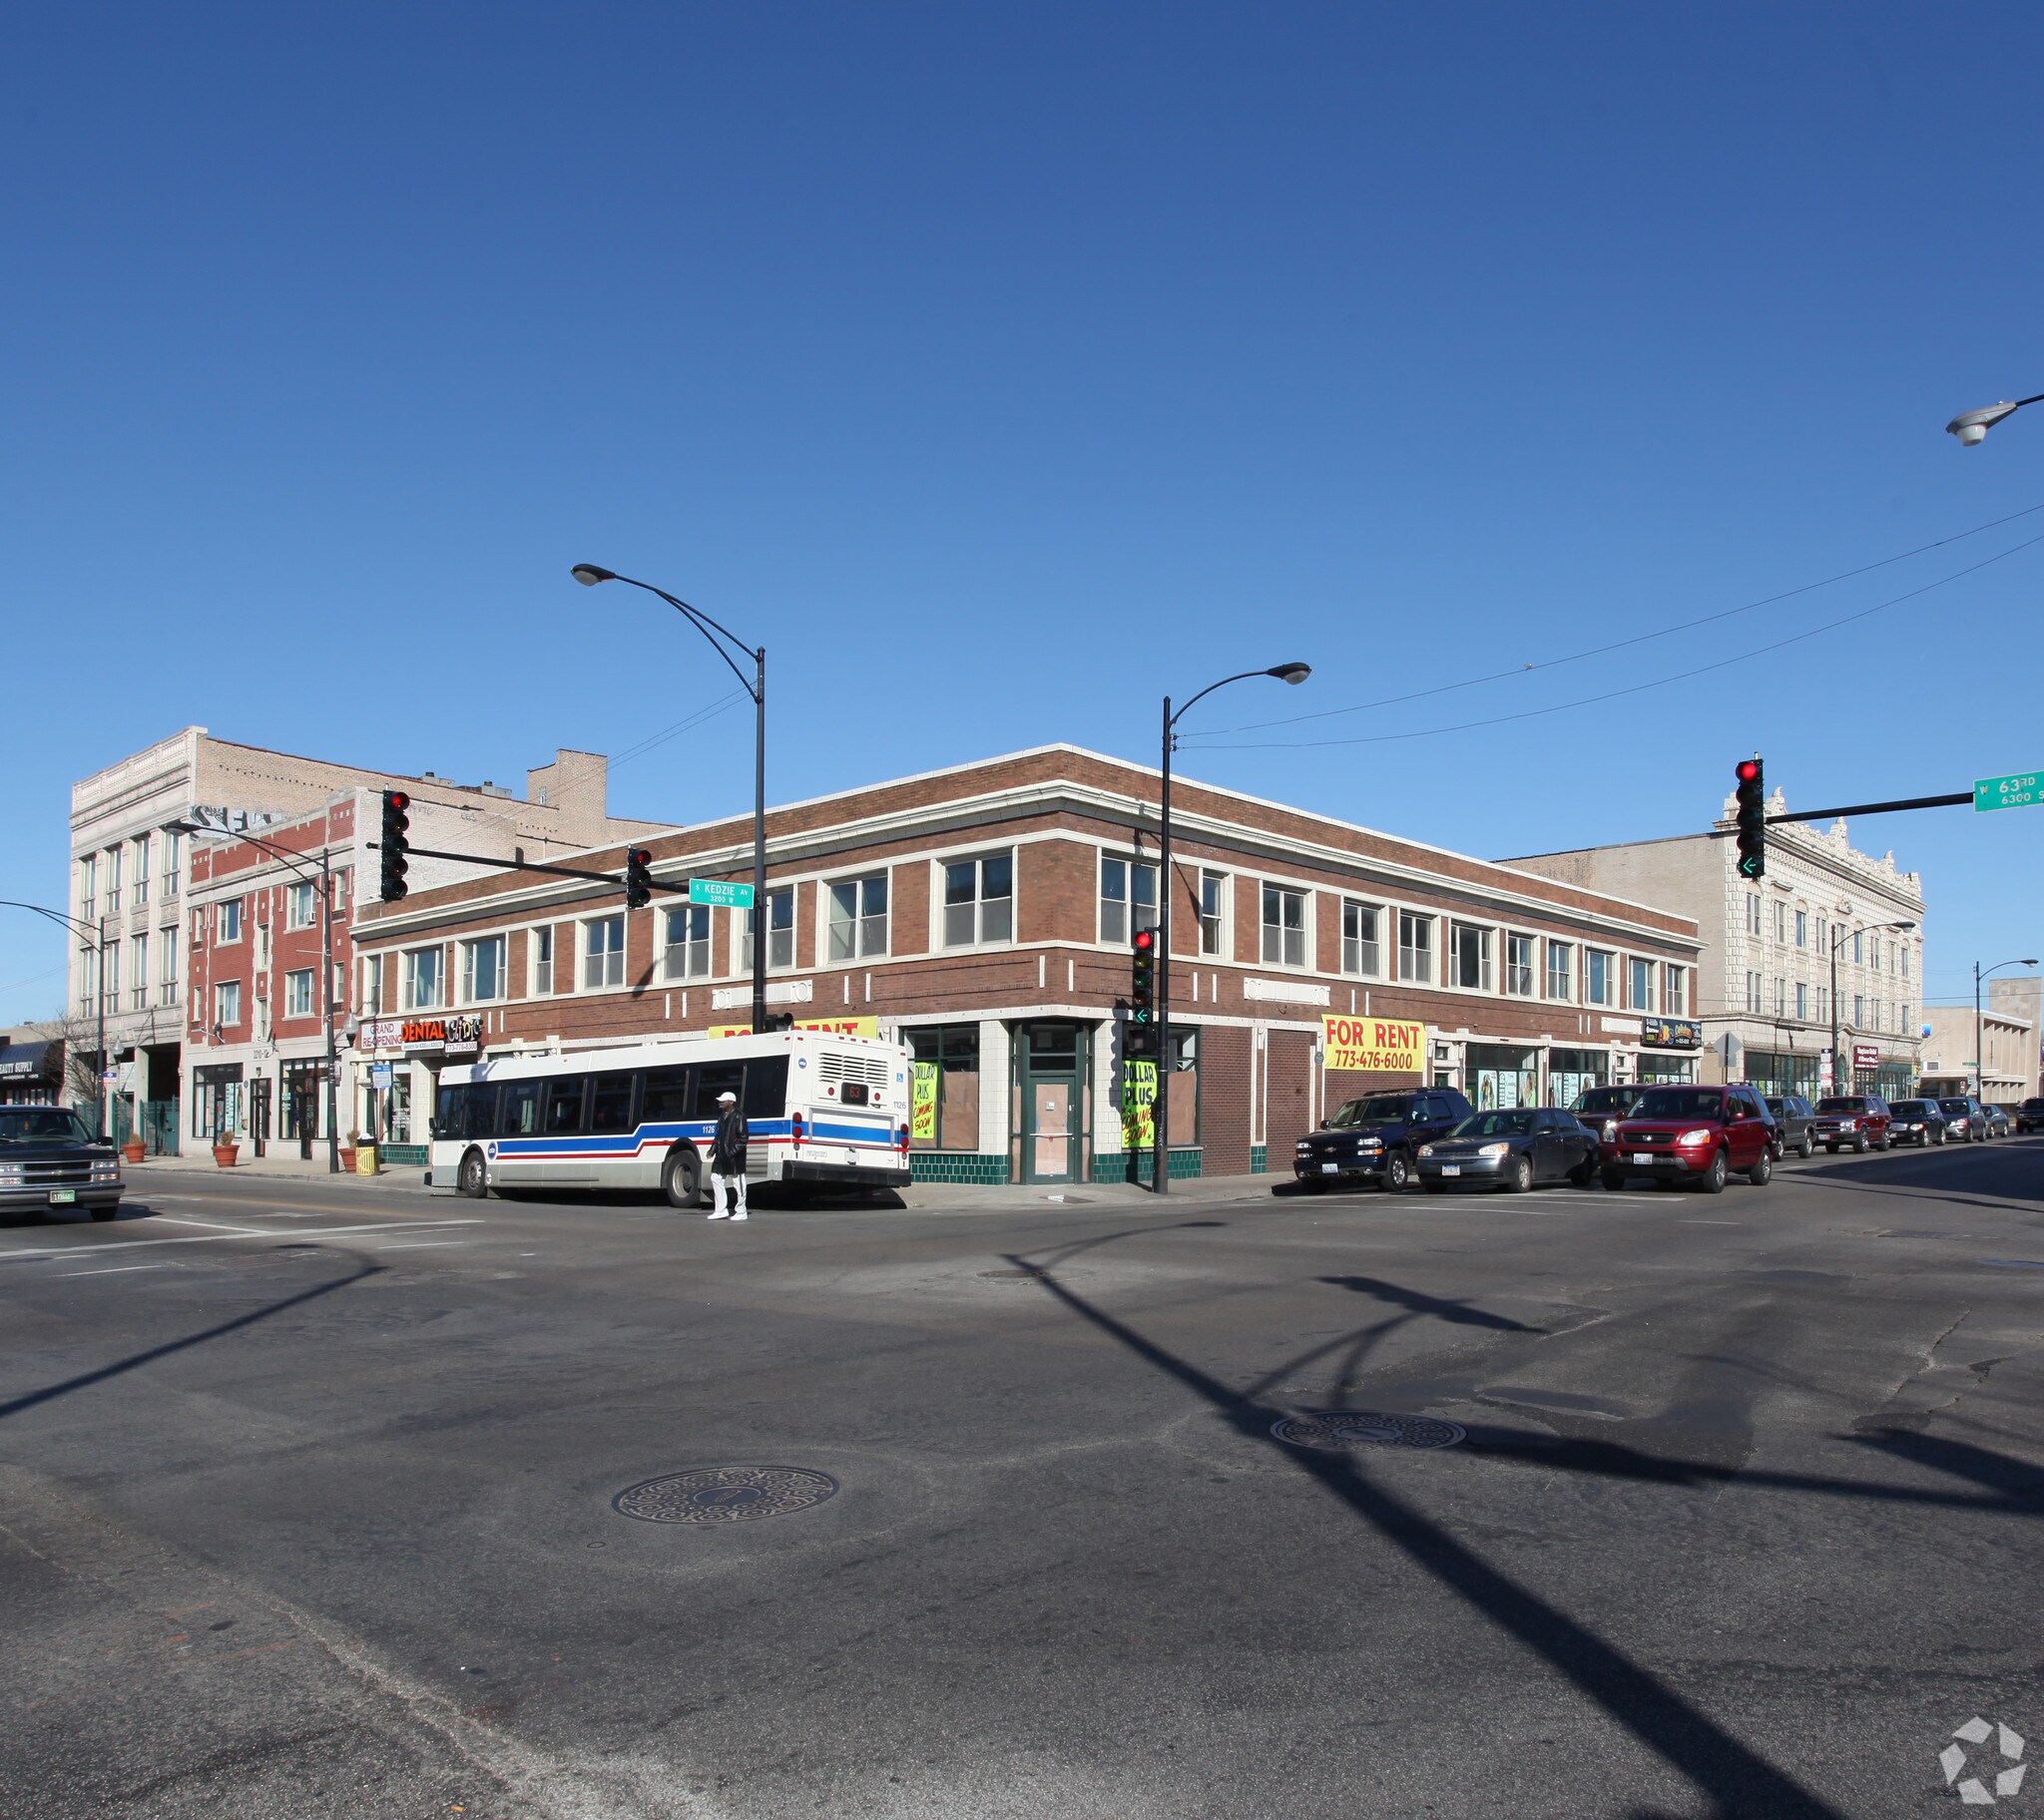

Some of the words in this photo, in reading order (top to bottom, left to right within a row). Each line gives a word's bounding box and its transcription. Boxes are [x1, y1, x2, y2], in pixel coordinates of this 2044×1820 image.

[1979, 785, 1988, 795] W
[1999, 776, 2035, 793] 63RD
[2001, 792, 2031, 805] 6300
[704, 884, 735, 896] KEDZIE
[370, 1023, 394, 1035] GRAND
[401, 1020, 445, 1042] DENTAL
[1326, 1019, 1363, 1047] FOR
[1374, 1023, 1419, 1050] RENT
[15, 1061, 33, 1073] SUPPLY
[1335, 1050, 1412, 1070] 773-476-6000
[915, 1065, 935, 1080] DOLLAR
[1123, 1065, 1155, 1083] DOLLAR
[849, 1087, 860, 1098] 63
[916, 1083, 929, 1099] PLUS
[1125, 1087, 1153, 1106] PLUS
[893, 1101, 906, 1110] 1126
[913, 1101, 933, 1119] COMING
[914, 1116, 932, 1131] SOON
[1122, 1109, 1153, 1131] COMING
[703, 1125, 716, 1134] 1126
[1125, 1123, 1150, 1144] SOON
